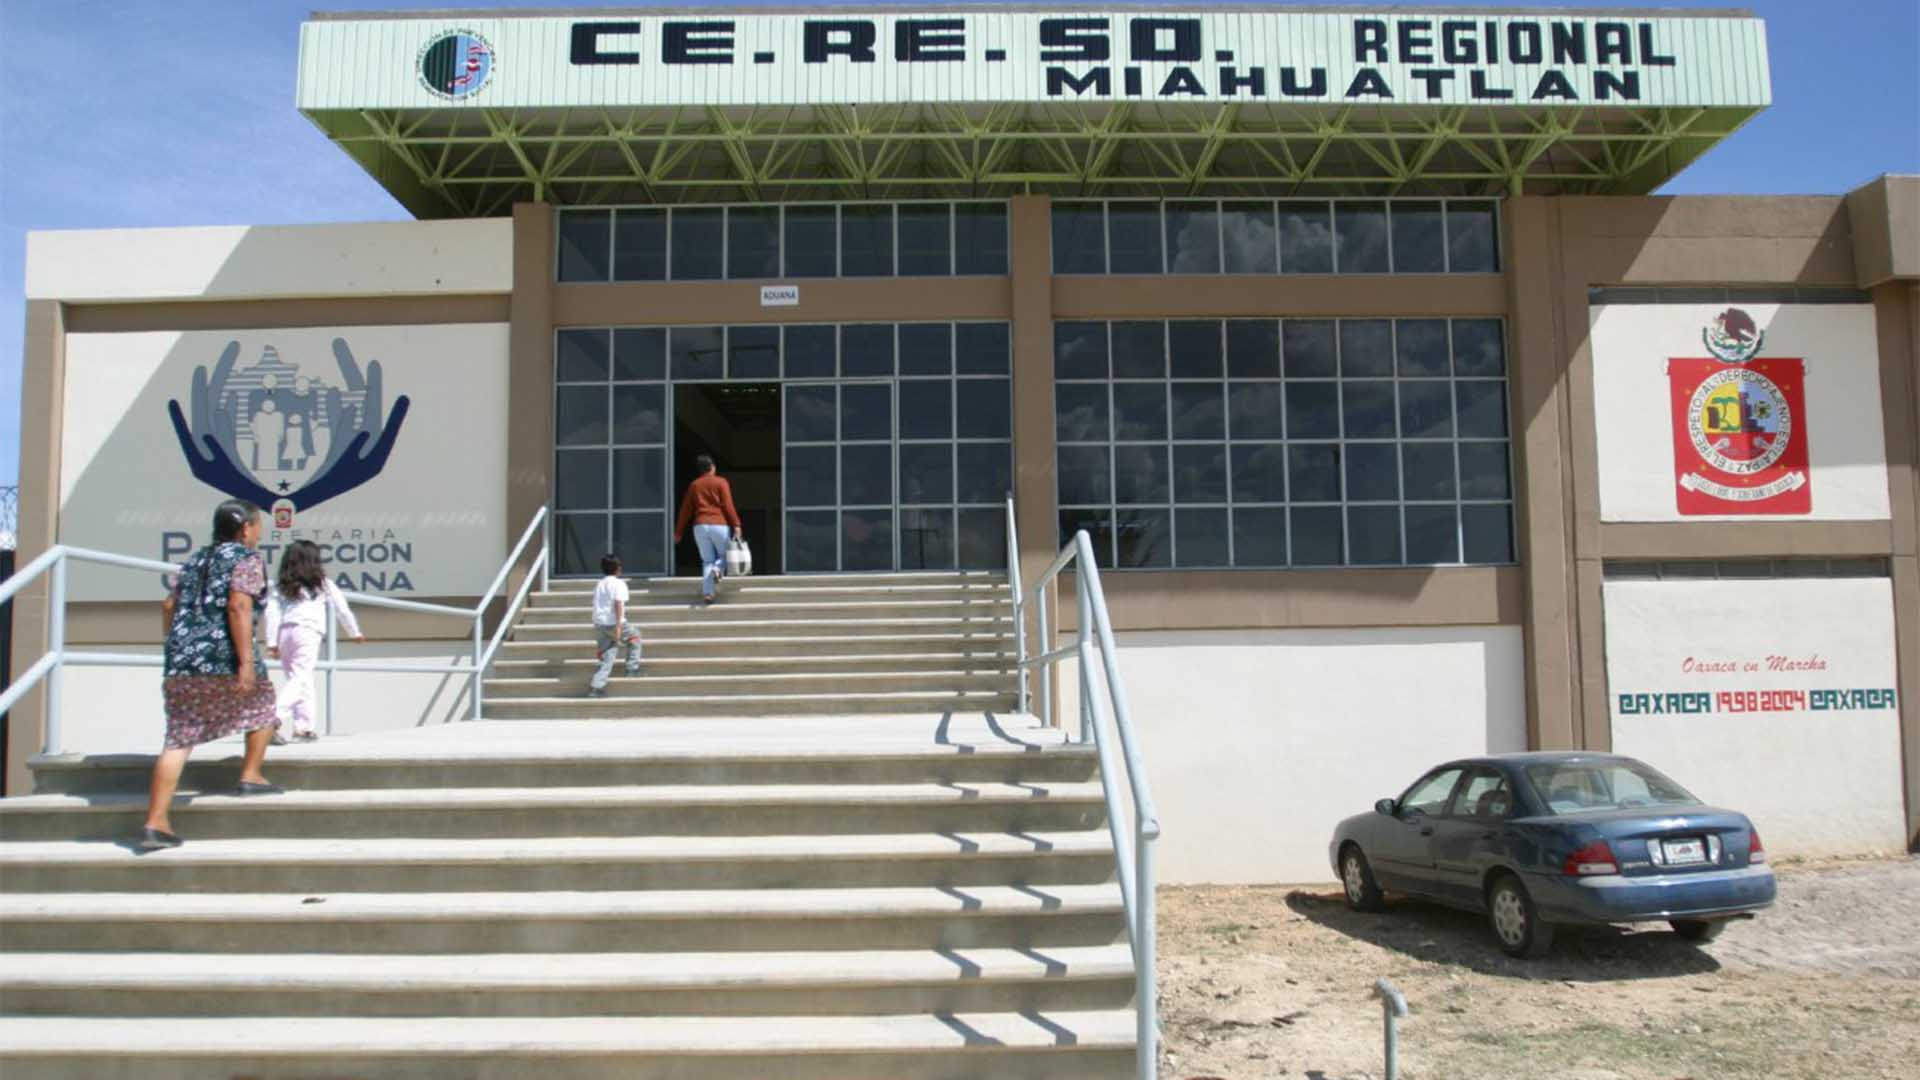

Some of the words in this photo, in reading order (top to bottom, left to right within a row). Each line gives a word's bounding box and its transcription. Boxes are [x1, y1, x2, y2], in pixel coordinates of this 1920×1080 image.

[1354, 19, 1676, 66] REGIONAL
[1047, 66, 1641, 99] MIAHUATLAN
[271, 528, 395, 541] RETARIA
[1682, 656, 1737, 673] Oaxaca
[1743, 663, 1759, 672] en
[1765, 654, 1827, 672] Marcha
